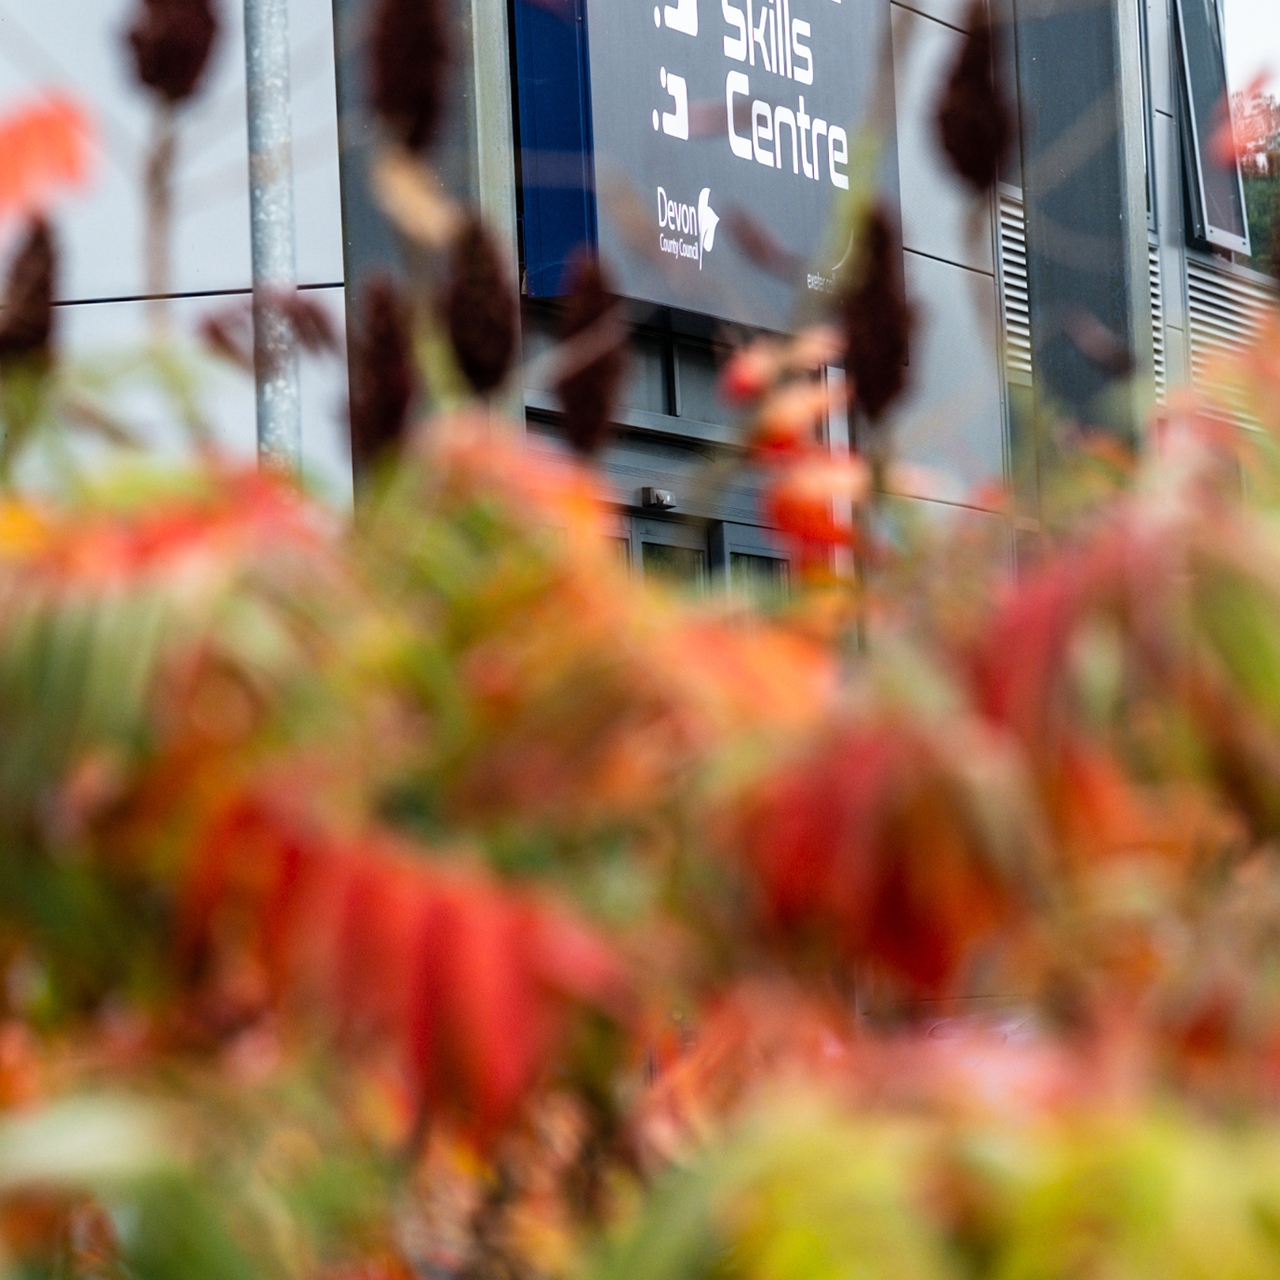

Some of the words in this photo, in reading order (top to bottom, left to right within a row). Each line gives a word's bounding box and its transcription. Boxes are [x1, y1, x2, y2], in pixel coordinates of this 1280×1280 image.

[725, 69, 850, 190] Centre
[657, 186, 698, 236] Devon
[660, 233, 679, 259] County
[679, 238, 699, 260] Council
